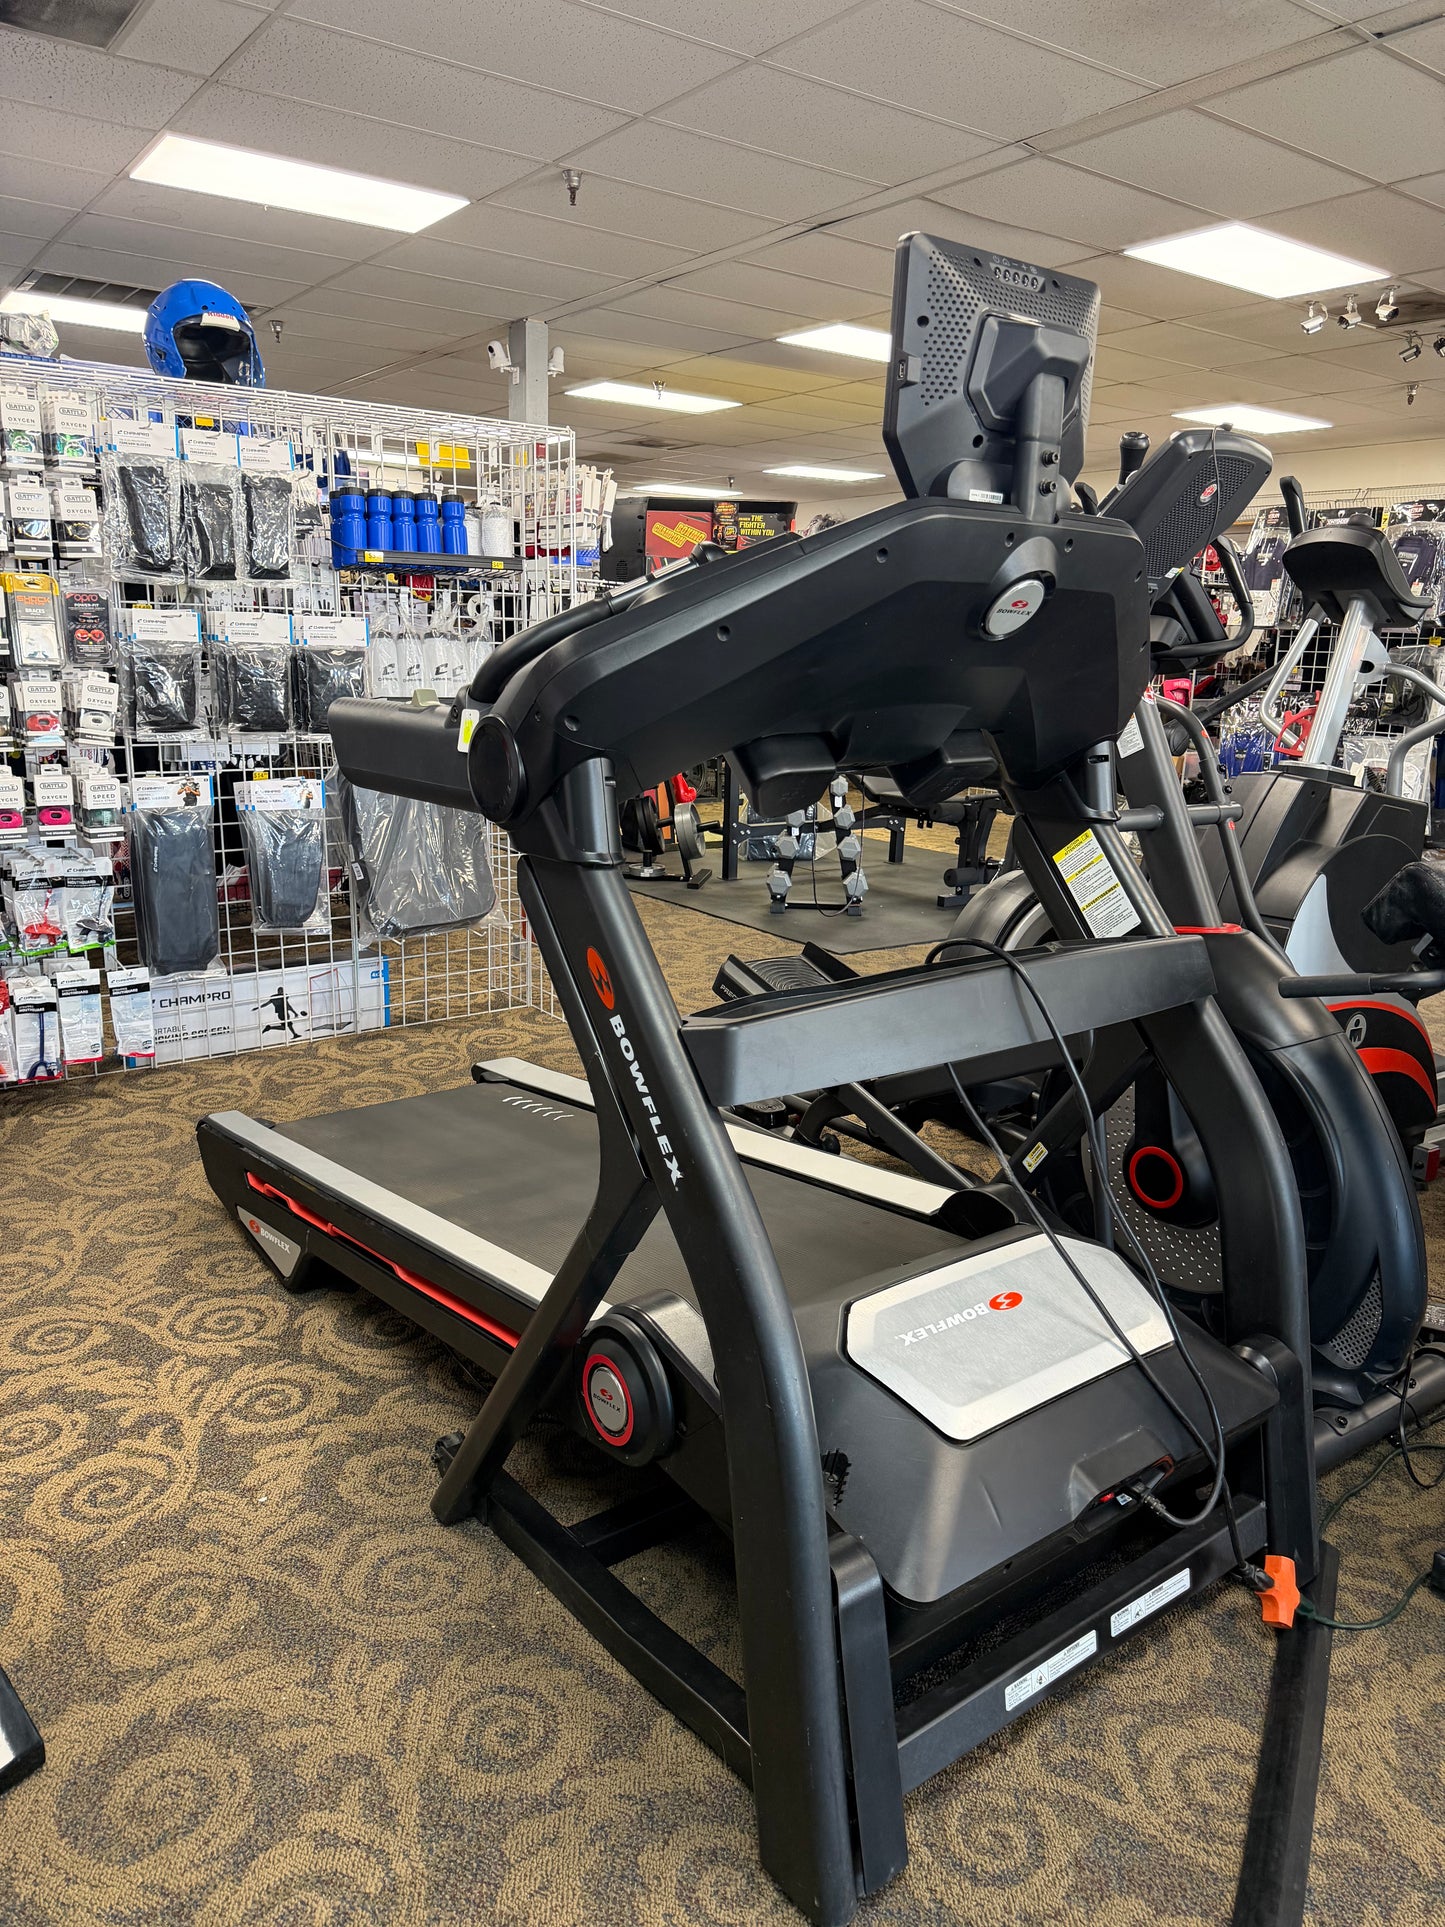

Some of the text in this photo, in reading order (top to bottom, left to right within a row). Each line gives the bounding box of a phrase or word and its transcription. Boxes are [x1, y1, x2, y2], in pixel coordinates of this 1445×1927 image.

[739, 521, 766, 529] FIGHTER
[996, 608, 1032, 616] BOWFLEX
[159, 990, 231, 1009] CHAMPRO
[155, 1024, 187, 1035] ORTABLE
[609, 1014, 684, 1186] BOWFLEX
[260, 1227, 291, 1255] BOWFLEX
[902, 1302, 989, 1347] BOWFLEX
[592, 1392, 621, 1412] BOWFLEX
